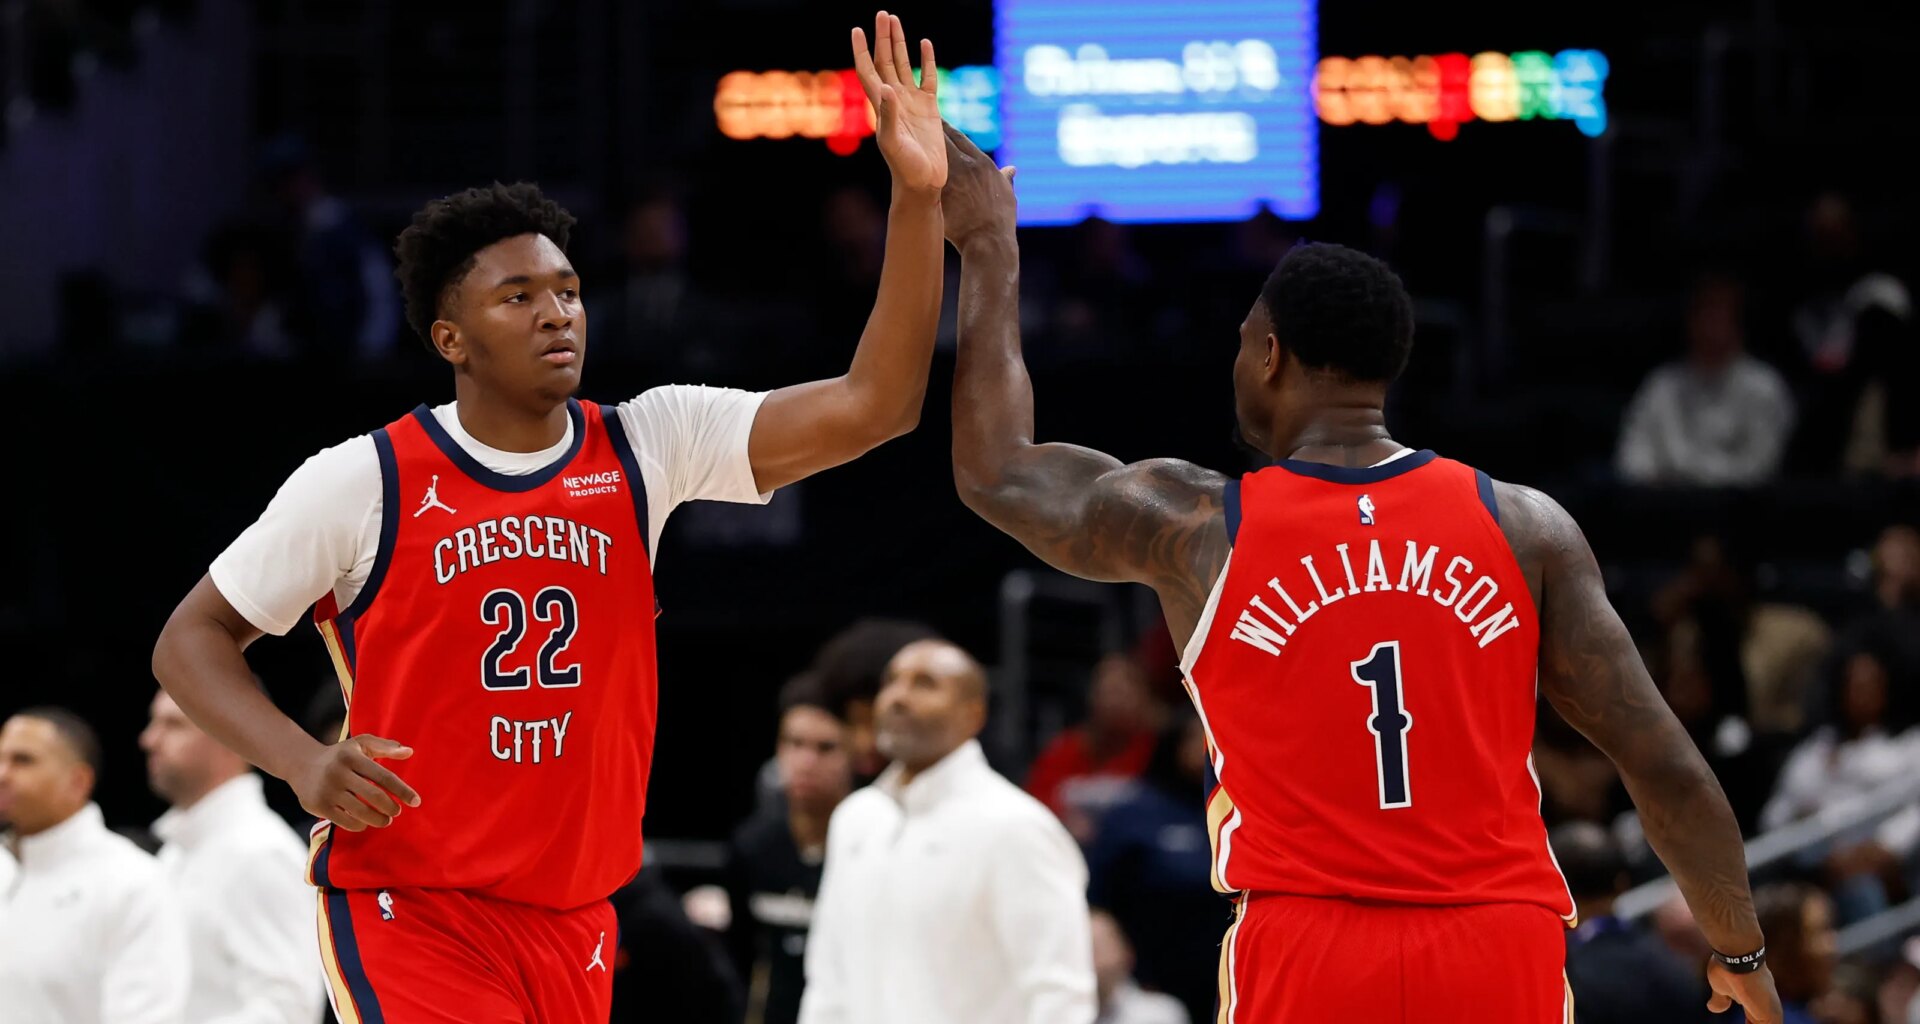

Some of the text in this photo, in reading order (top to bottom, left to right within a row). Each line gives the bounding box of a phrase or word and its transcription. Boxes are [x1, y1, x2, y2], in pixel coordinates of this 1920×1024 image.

[562, 470, 621, 489] NEWAGE
[569, 485, 618, 497] PRODUCTS
[434, 515, 612, 584] CRESCENT
[1229, 539, 1520, 657] WILLIAMSON
[480, 585, 582, 691] 22
[489, 710, 572, 764] CITY
[1350, 640, 1413, 810] 1
[1742, 954, 1754, 963] TO
